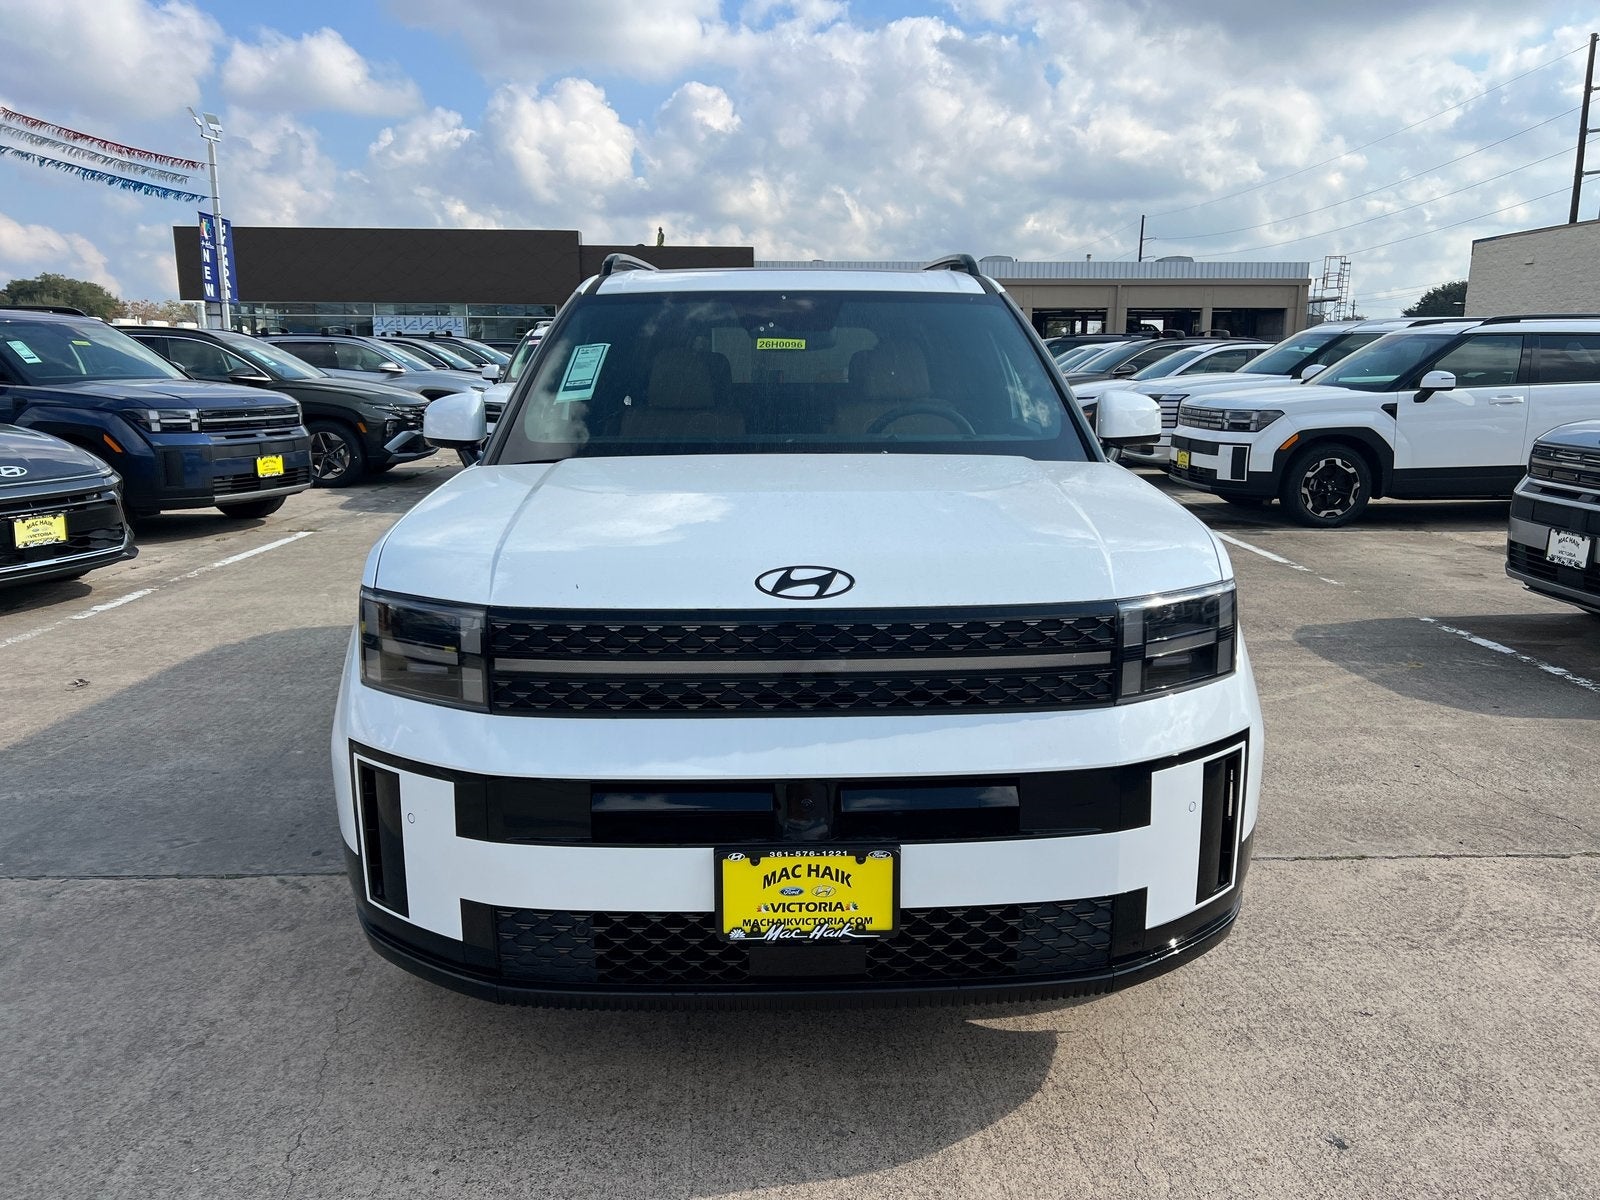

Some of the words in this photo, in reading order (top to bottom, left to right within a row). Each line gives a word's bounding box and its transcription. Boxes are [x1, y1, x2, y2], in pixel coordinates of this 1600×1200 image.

[203, 248, 215, 297] NEW
[758, 340, 803, 349] 26H0096
[769, 850, 848, 858] 361-576-1221
[762, 864, 802, 889] MAC
[807, 863, 852, 888] HAIK
[770, 902, 845, 913] VICTORIA
[742, 916, 873, 927] MACHAIKVICTORIACOM
[763, 923, 804, 941] Mac
[808, 923, 857, 940] Haik
